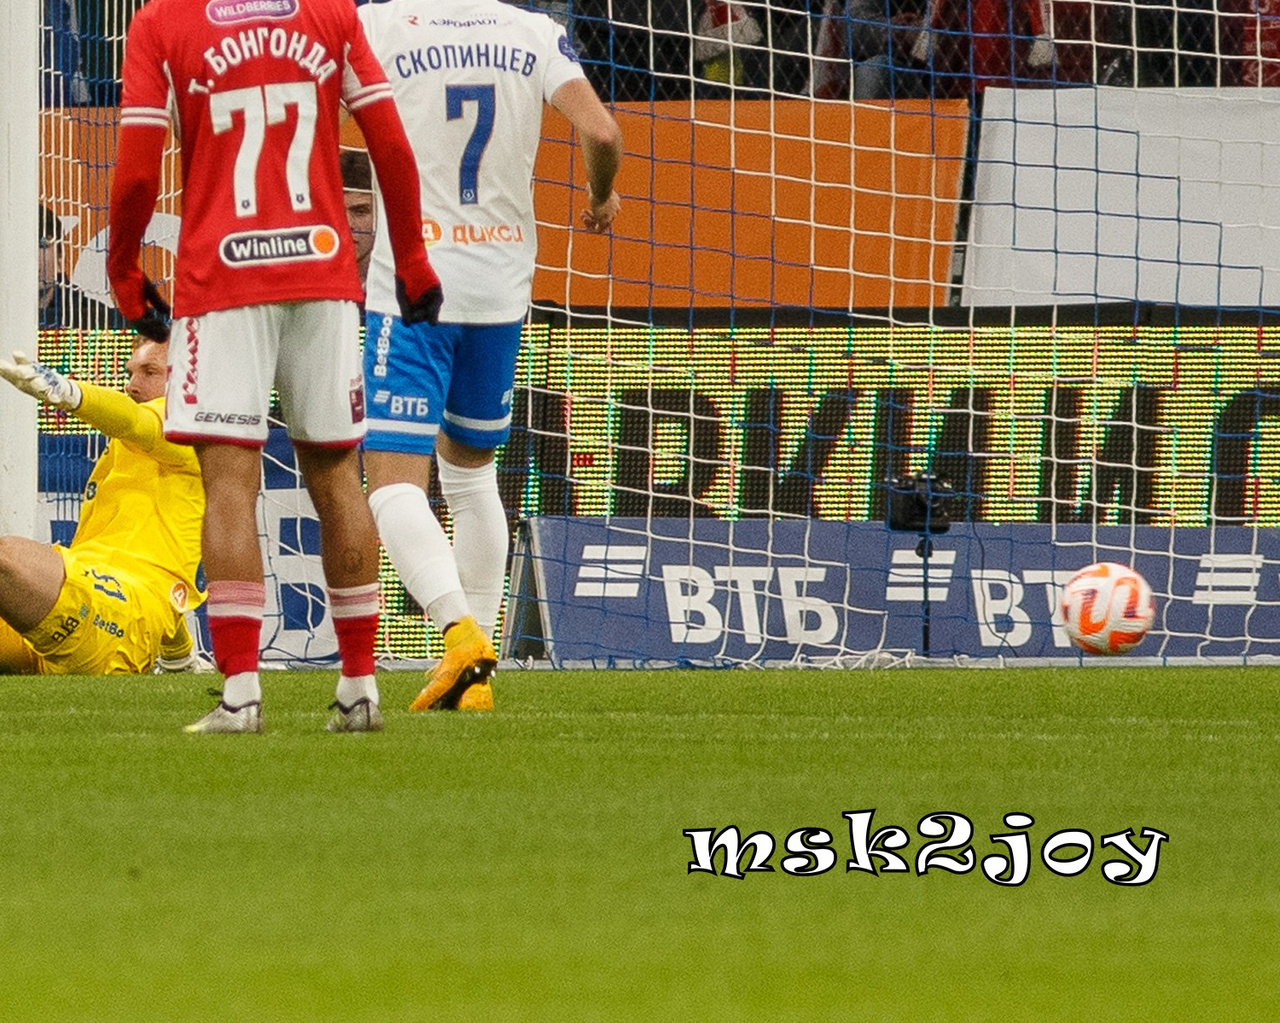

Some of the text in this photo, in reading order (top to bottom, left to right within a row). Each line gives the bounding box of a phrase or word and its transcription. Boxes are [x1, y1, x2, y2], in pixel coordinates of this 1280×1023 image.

[215, 0, 292, 17] WILDBERRIES
[203, 27, 338, 85] БОНГОНДА
[395, 43, 537, 78] СКОПИНЦЕВ
[209, 81, 317, 218] 77
[445, 84, 496, 205] 7
[231, 234, 308, 260] Winline
[373, 315, 393, 377] BetBoo
[194, 411, 261, 425] GENESIS
[390, 395, 429, 416] ВТБ
[662, 565, 838, 645] ВТБ
[970, 569, 1080, 648] ВТ
